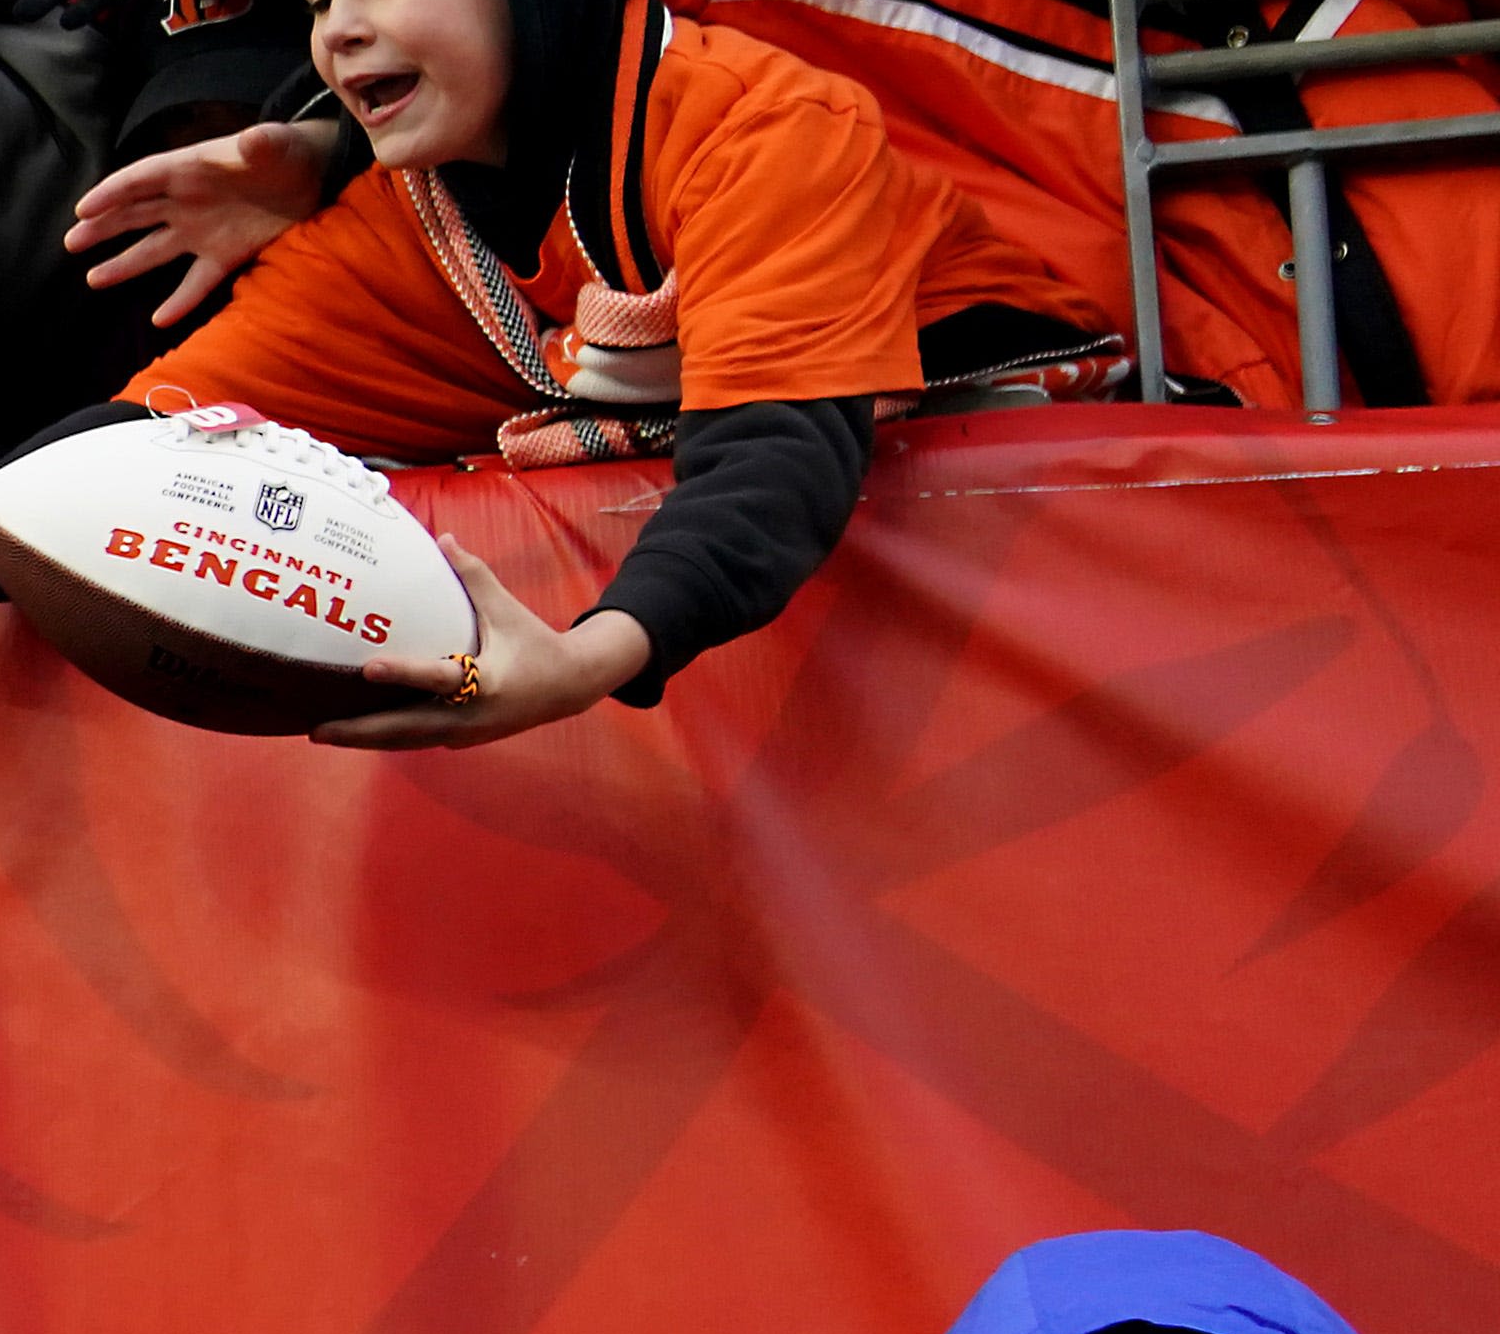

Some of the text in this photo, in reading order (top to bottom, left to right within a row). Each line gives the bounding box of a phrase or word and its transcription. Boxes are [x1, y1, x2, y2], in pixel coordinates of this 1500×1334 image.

[173, 481, 231, 501] FOOTBALL
[176, 472, 234, 491] AMERICAN
[161, 488, 236, 513] CONFERENCE
[259, 500, 297, 527] NFL
[313, 534, 379, 566] CONFERENCE
[323, 527, 374, 553] FOOTBALL
[173, 521, 354, 591] CINCINNATI
[103, 527, 392, 646] BENGALS
